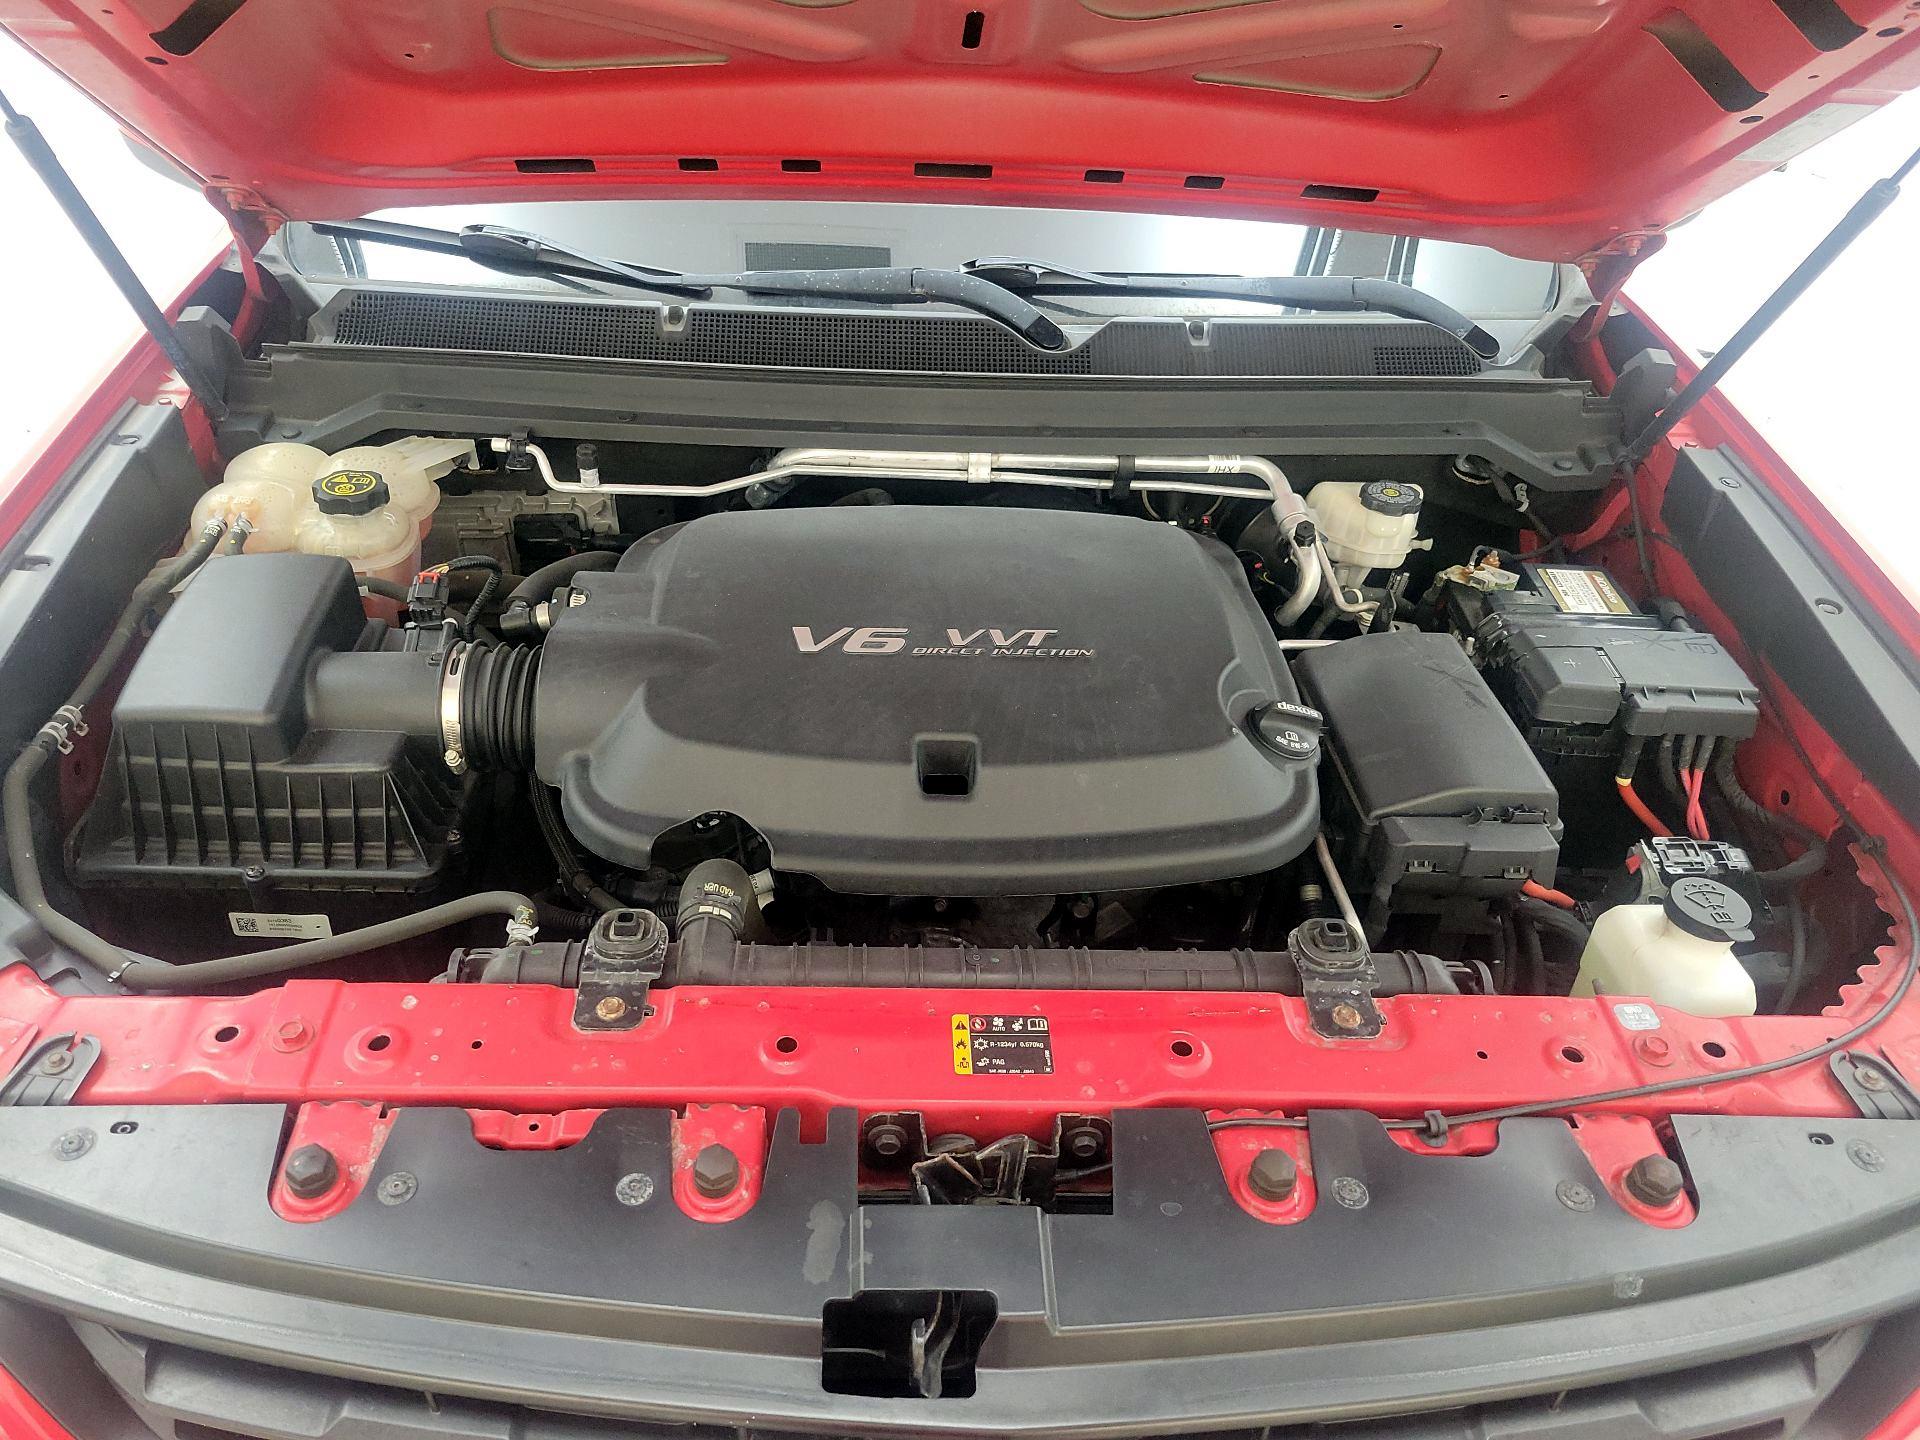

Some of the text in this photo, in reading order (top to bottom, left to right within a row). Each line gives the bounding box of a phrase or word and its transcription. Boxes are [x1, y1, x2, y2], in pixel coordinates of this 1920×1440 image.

[792, 626, 1059, 655] V6 VVT
[912, 647, 1096, 658] DIRECT INJECTION
[1276, 701, 1319, 718] dexos
[719, 885, 735, 897] RAD
